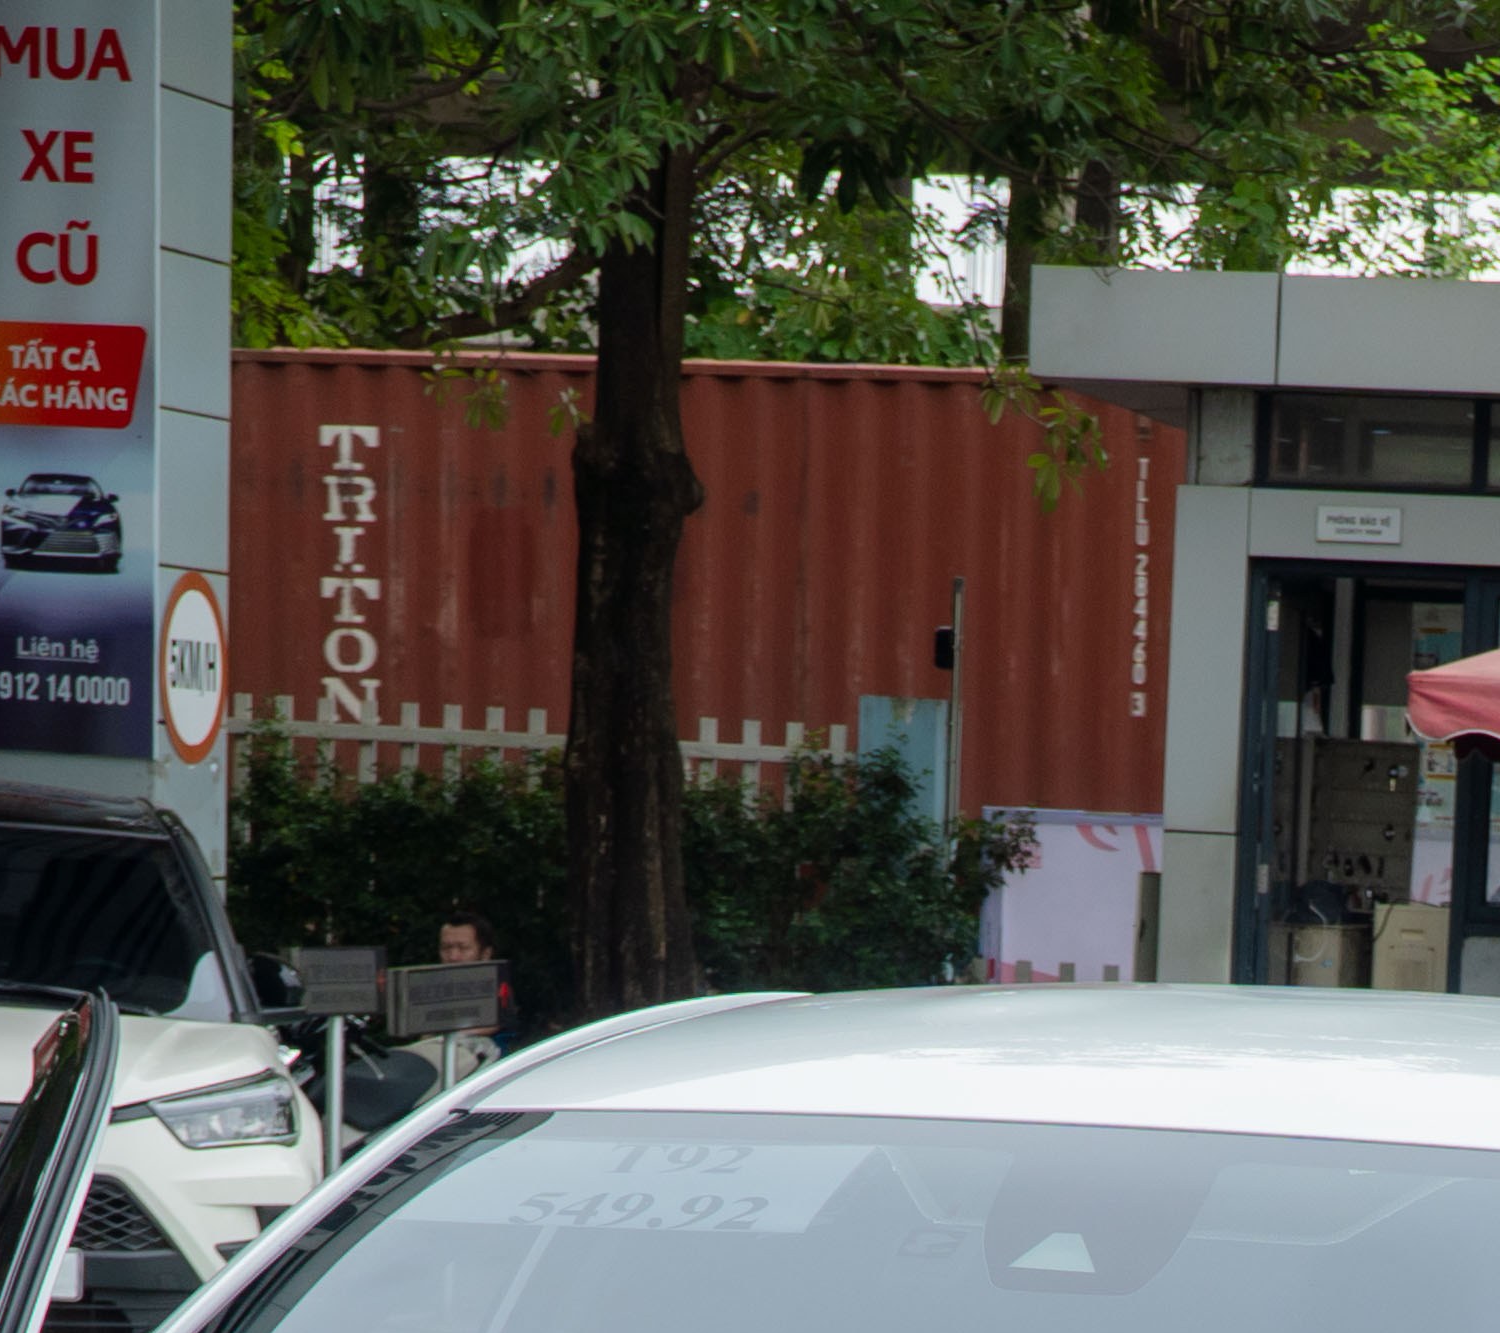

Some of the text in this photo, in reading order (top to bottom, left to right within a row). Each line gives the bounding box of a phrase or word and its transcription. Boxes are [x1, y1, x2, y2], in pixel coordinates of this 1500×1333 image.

[20, 129, 94, 184] XE
[16, 220, 99, 286] CŨ
[8, 338, 101, 372] TẤT CẢ
[43, 380, 128, 411] HÃNG
[318, 424, 381, 724] TRITON
[16, 636, 100, 662] Liên hệ
[605, 1143, 757, 1174] T92
[508, 1191, 770, 1230] 549.92
